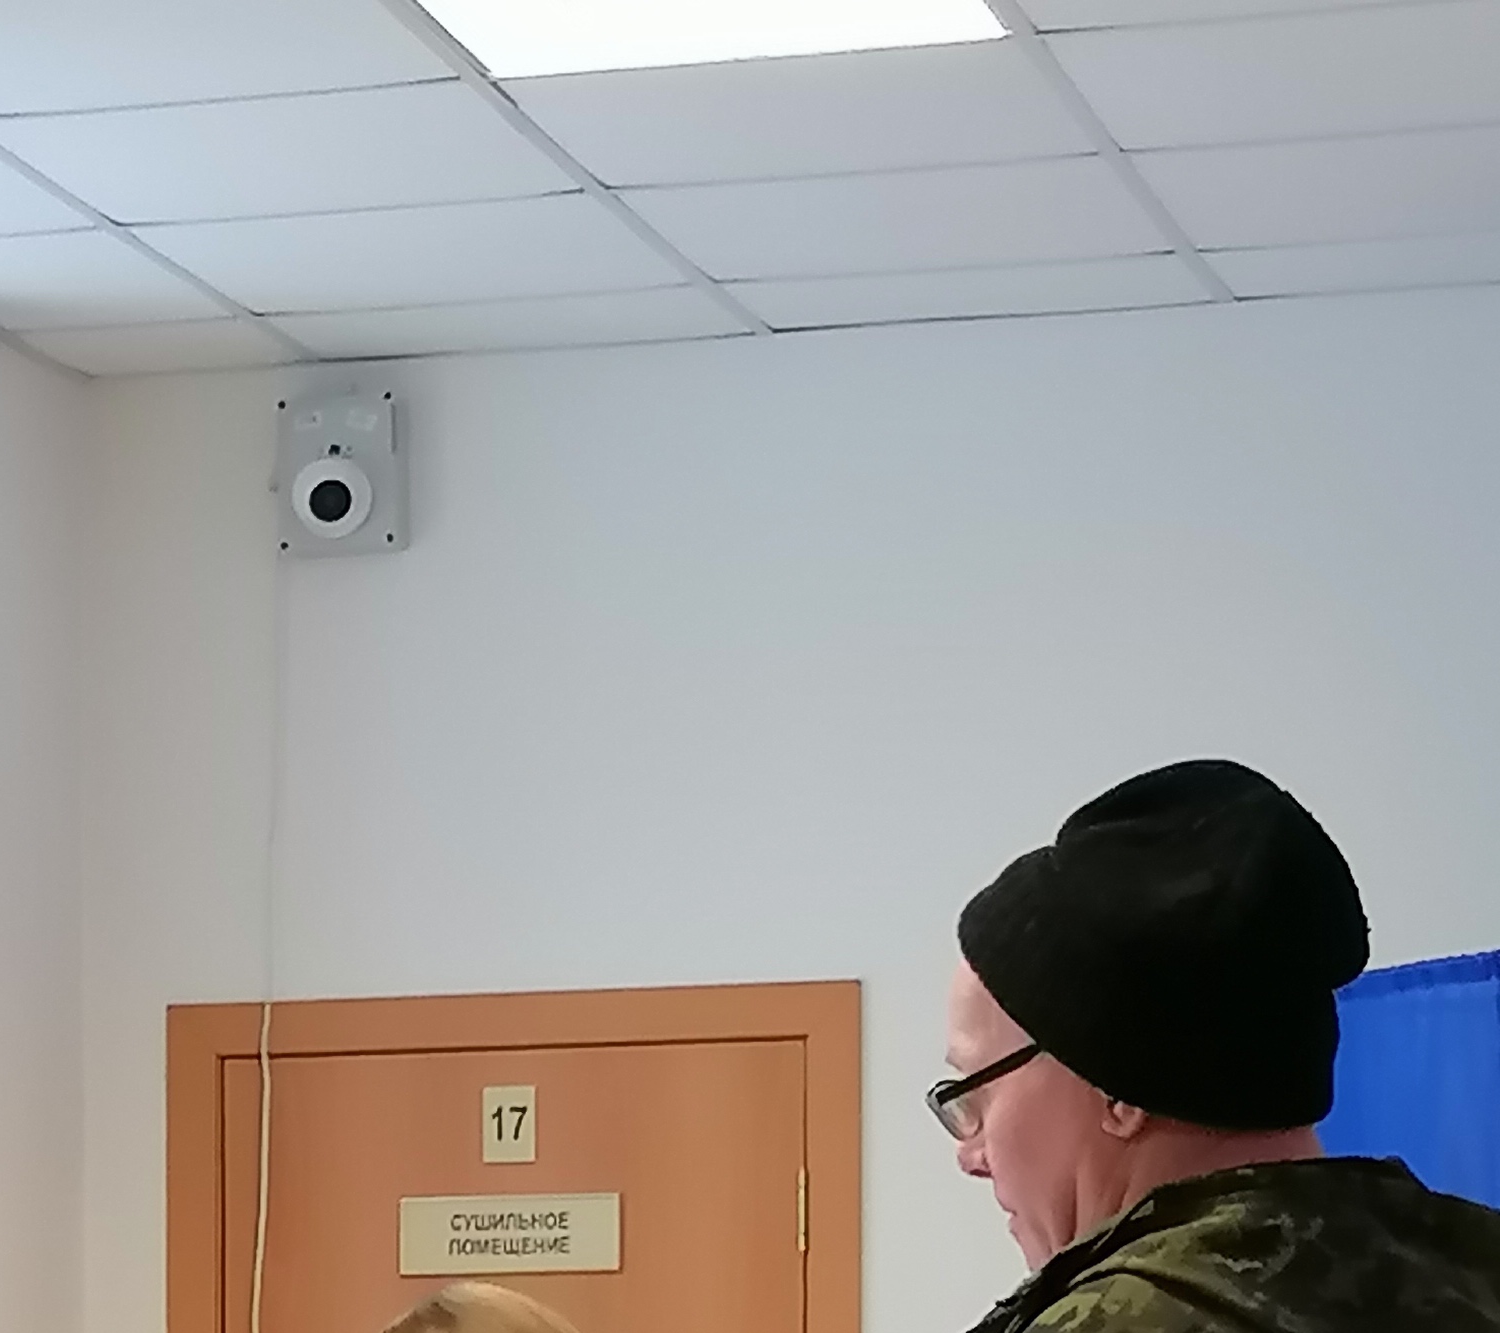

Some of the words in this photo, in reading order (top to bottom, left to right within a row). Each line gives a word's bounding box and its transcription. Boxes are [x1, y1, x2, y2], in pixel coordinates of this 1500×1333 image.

[492, 1106, 528, 1141] 17
[450, 1211, 570, 1231] СУШИЛЬНОЕ
[448, 1236, 570, 1257] ПОМЕЩЕНИЕ
